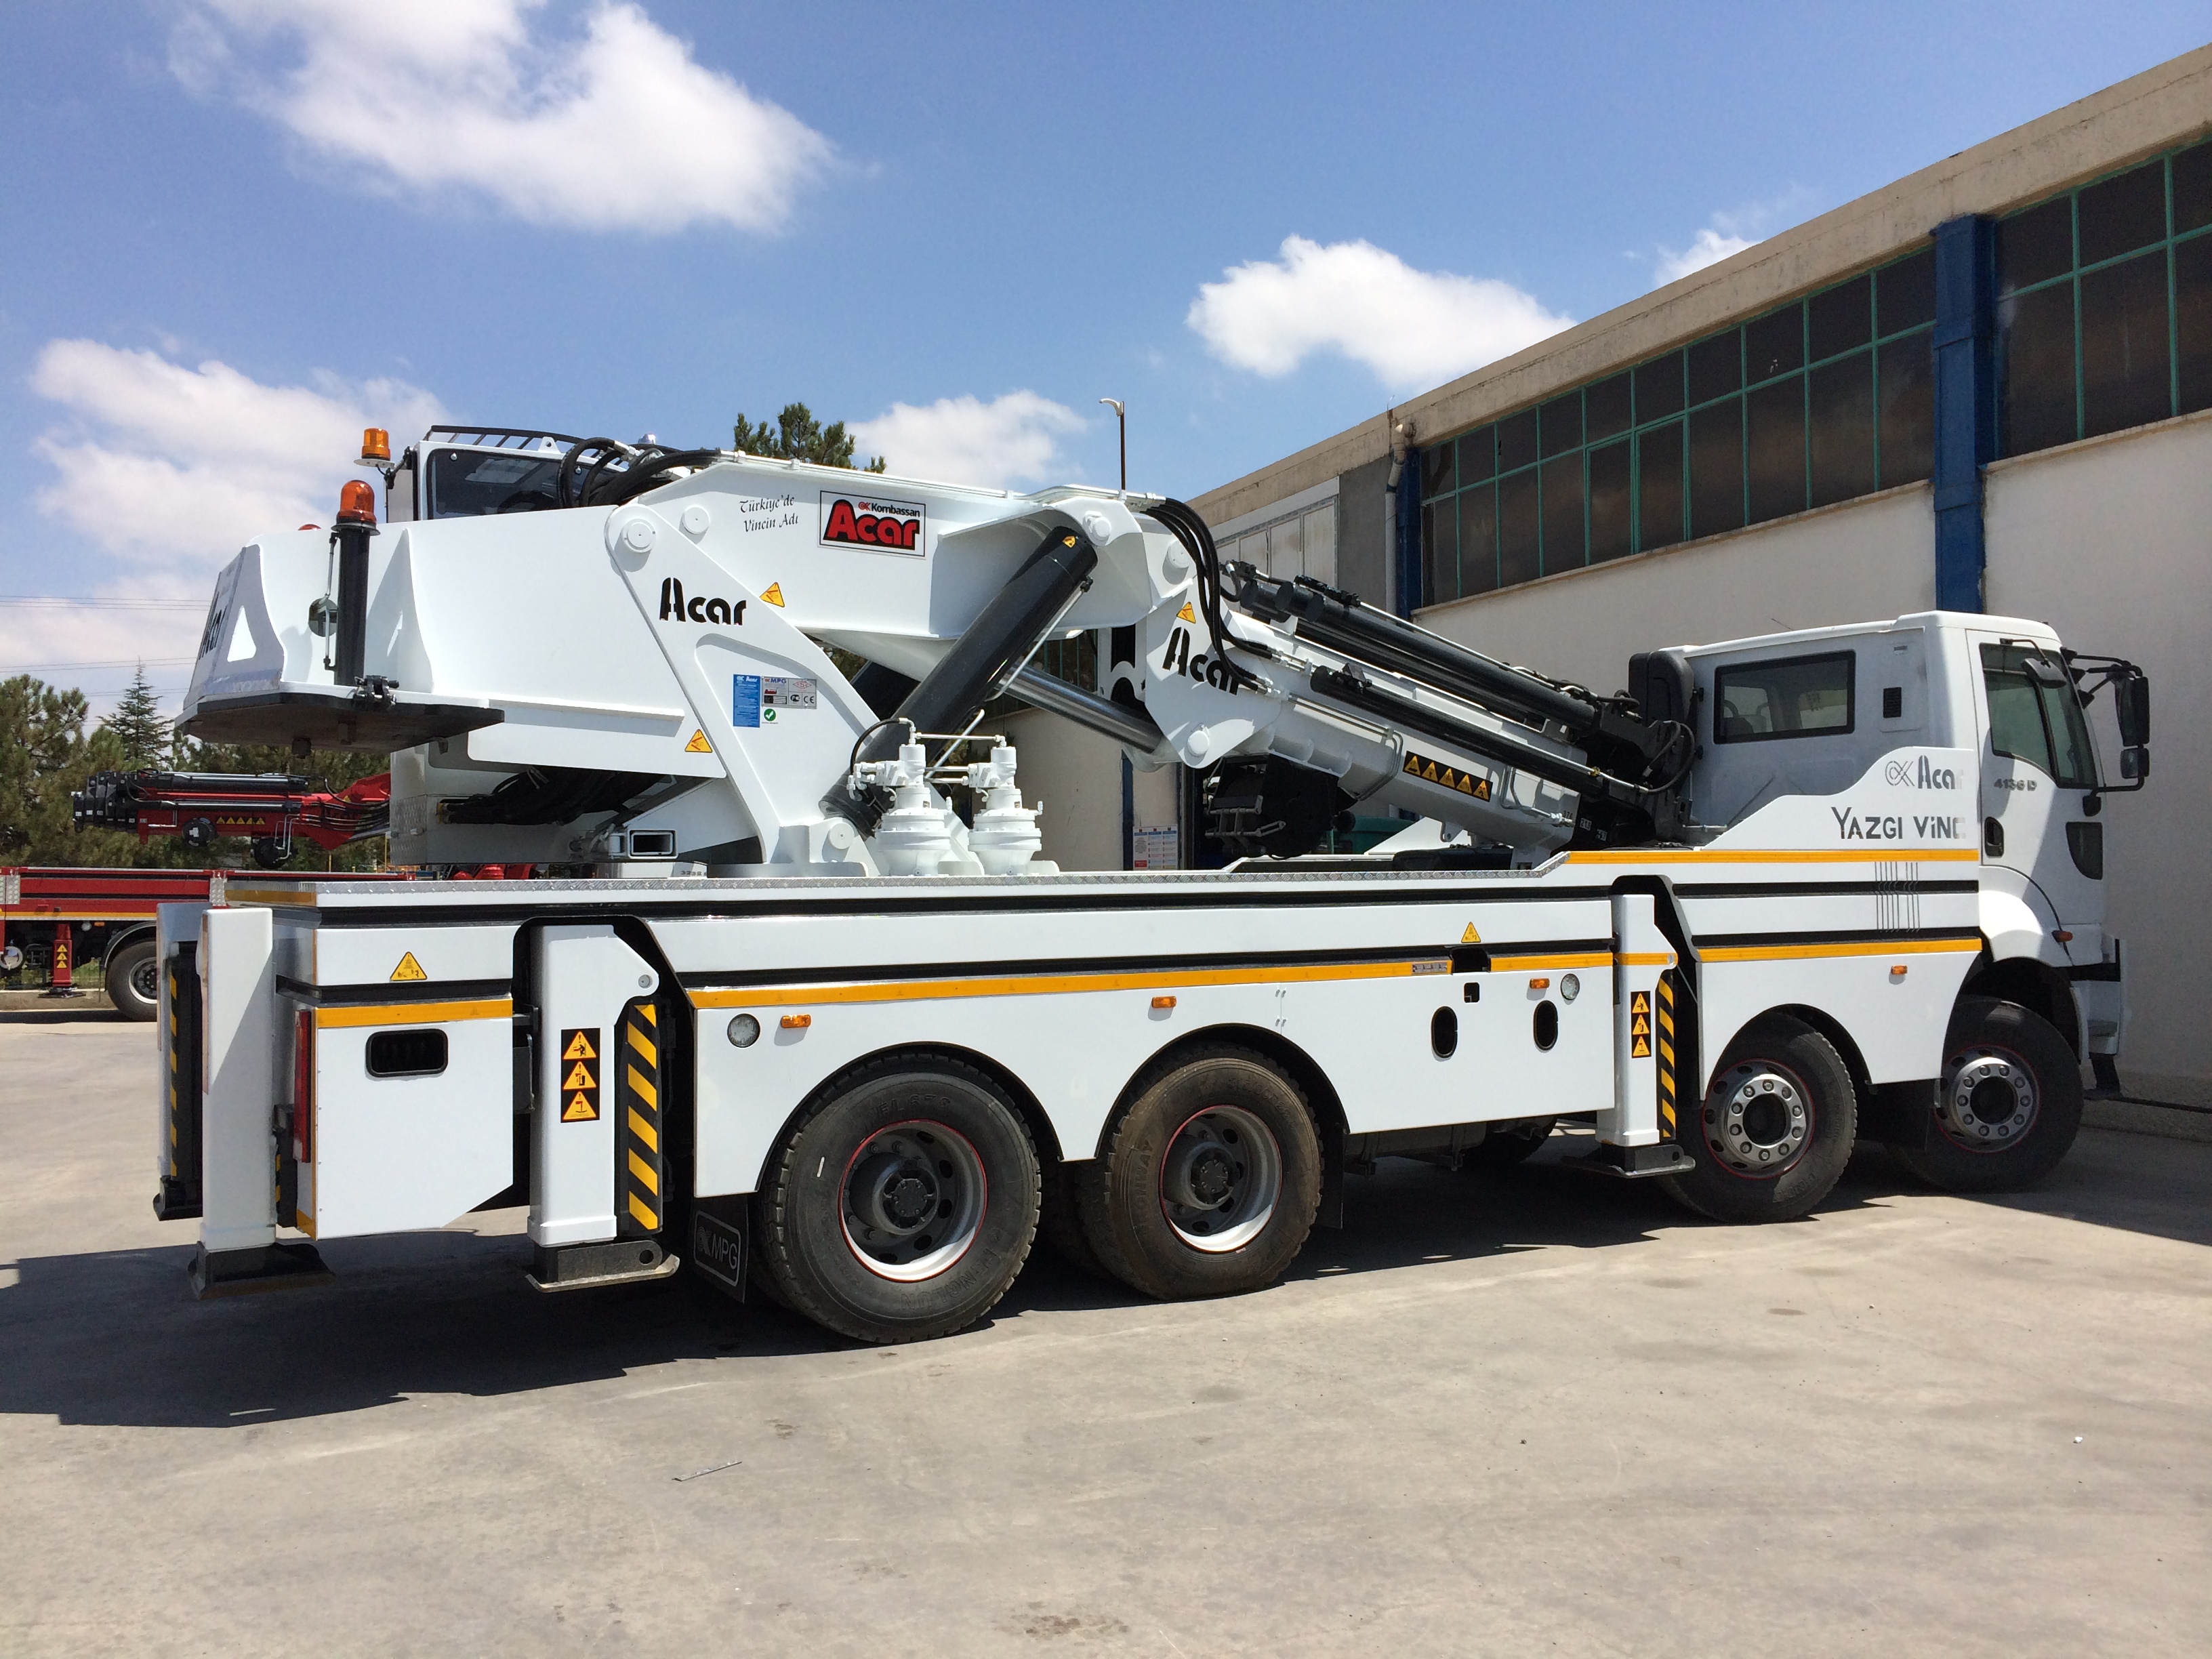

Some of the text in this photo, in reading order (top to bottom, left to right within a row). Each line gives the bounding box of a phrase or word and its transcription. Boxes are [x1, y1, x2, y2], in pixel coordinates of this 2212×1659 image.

[739, 494, 795, 513] Türkiye'de
[871, 502, 920, 517] Kombassan
[743, 517, 776, 532] Vincin
[823, 499, 920, 550] Acar
[659, 577, 746, 626] Acar
[1830, 806, 1903, 840] YAZGI
[711, 1233, 738, 1270] MPG
